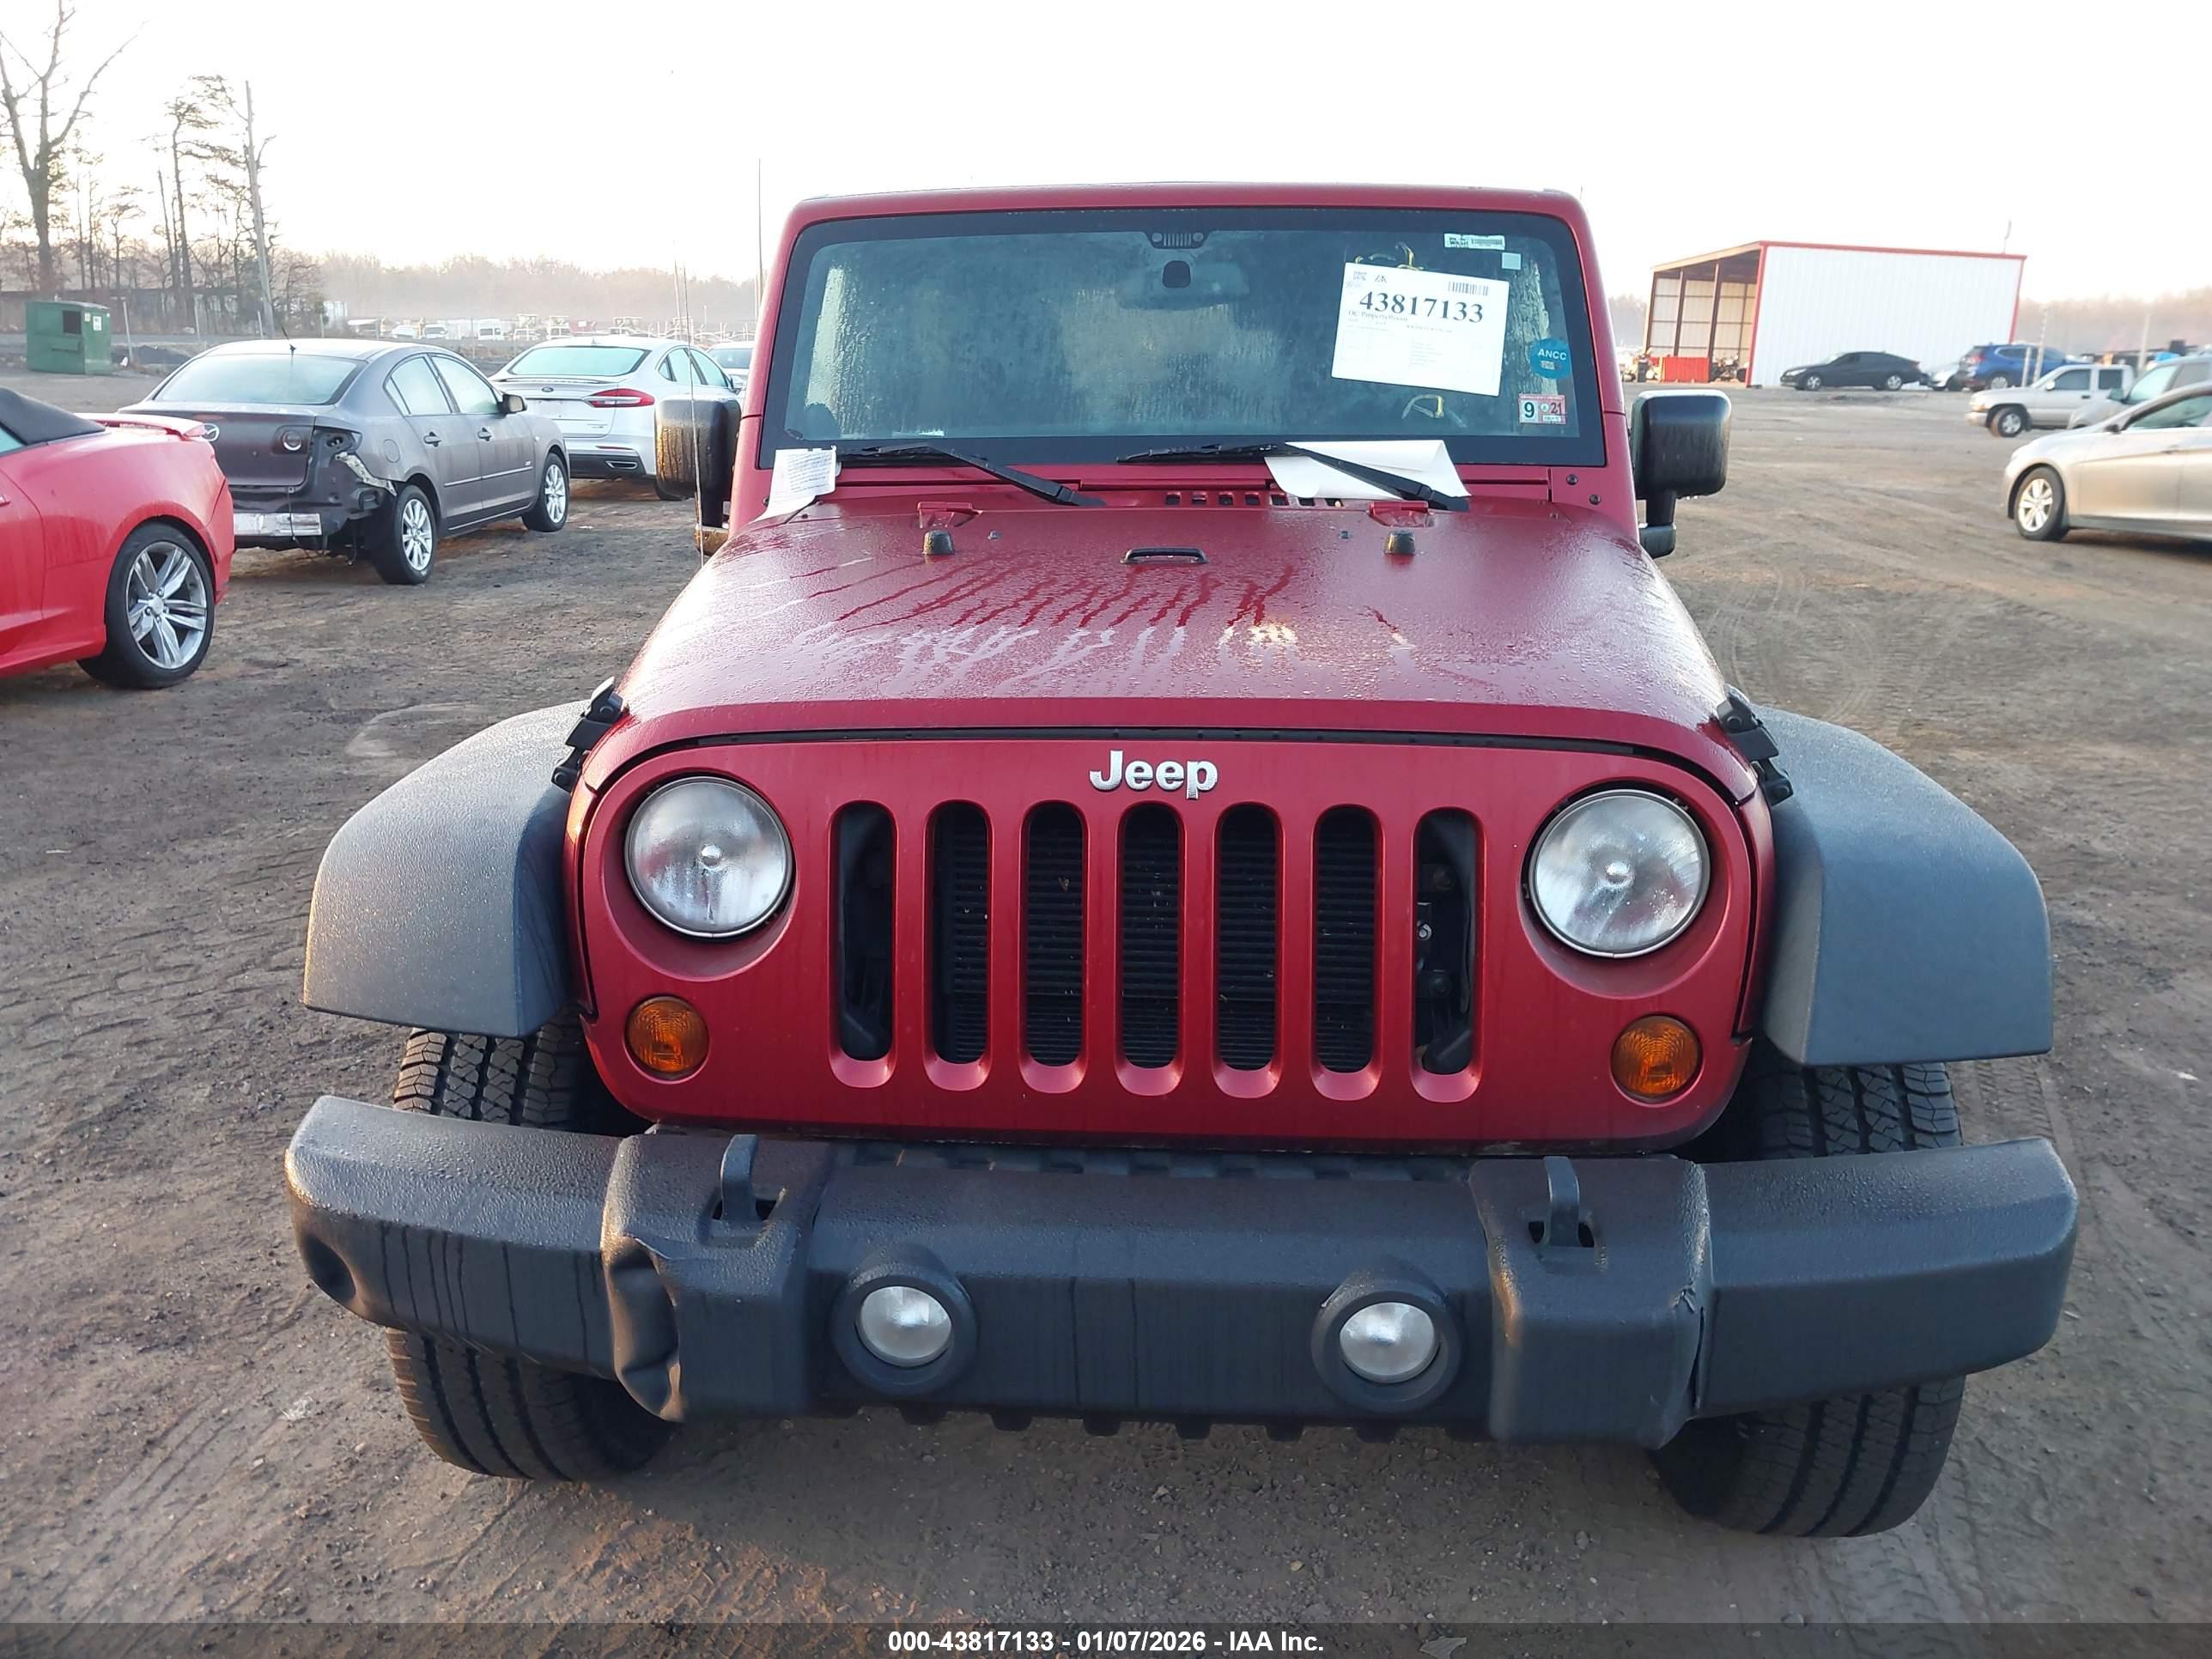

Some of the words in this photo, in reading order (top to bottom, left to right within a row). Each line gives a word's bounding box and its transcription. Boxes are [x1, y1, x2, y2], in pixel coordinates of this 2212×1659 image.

[1359, 291, 1483, 323] 43817133
[1537, 348, 1567, 361] ANCC
[1524, 402, 1535, 418] 9
[1551, 402, 1563, 416] 21
[1089, 750, 1218, 799] Jeep
